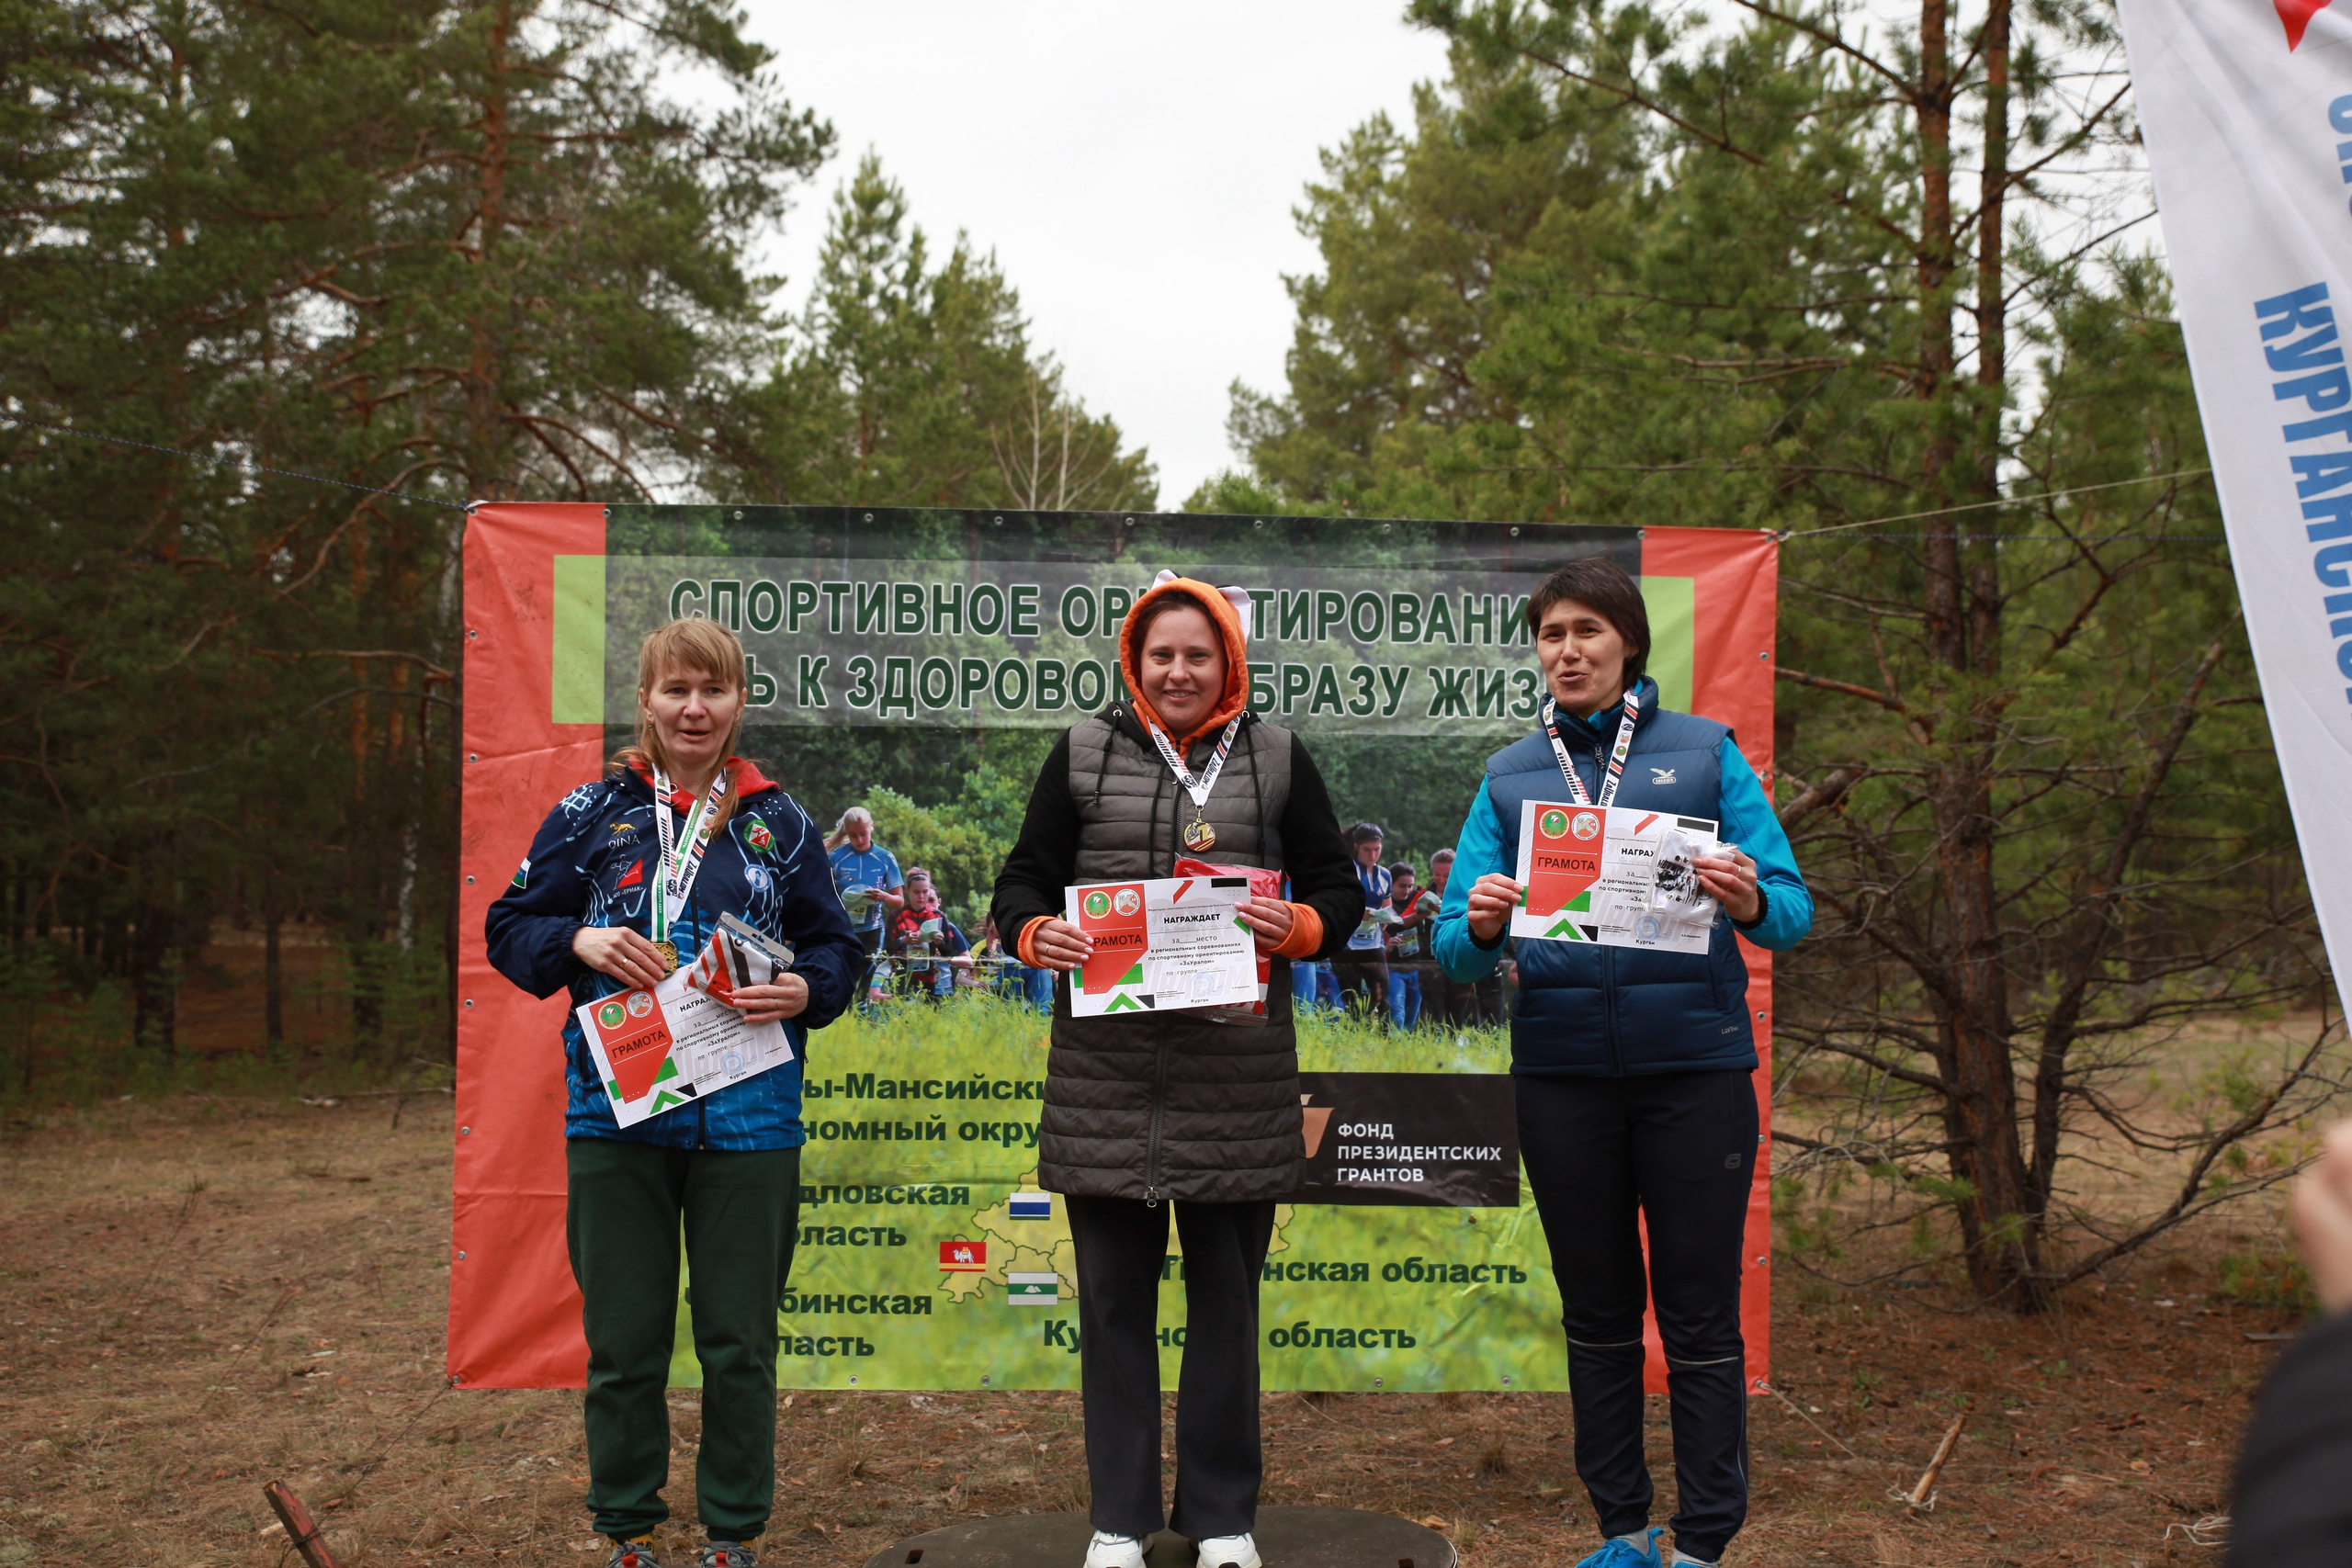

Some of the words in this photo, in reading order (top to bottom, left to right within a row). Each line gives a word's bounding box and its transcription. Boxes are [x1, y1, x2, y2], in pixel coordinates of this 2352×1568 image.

[2255, 281, 2352, 726] КУРГАН
[671, 579, 1040, 636] СПОРТИВНОЕ
[1060, 585, 1535, 647] ОРТИРОВАНИ
[798, 655, 829, 707] К
[847, 656, 1134, 718] ЗДОРОВО
[1246, 662, 1410, 717] БРАЗУ
[1427, 666, 1546, 719] ЖИЗ
[1621, 848, 1655, 857] НАГРА
[1537, 856, 1596, 872] ГРАМОТА
[1164, 913, 1220, 924] НАГРАЖДАЕТ
[1093, 933, 1143, 948] РАМОТА
[1197, 942, 1241, 951] соревнованиях
[1157, 953, 1194, 961] спортивному
[1195, 949, 1245, 958] ориентированию
[1177, 968, 1198, 976] группе
[680, 996, 711, 1012] НАГРА
[680, 1023, 718, 1044] региональных
[684, 1032, 719, 1050] спортивному
[612, 1030, 667, 1058] ГРАМОТА
[707, 1044, 728, 1057] группе
[729, 1070, 748, 1080] Курган
[804, 1073, 1045, 1100] ы-Мансийск
[803, 1114, 946, 1141] номный
[958, 1122, 1041, 1148] окру
[1338, 1122, 1395, 1140] ФОНД
[1338, 1145, 1502, 1161] ПРЕЗИДЕНТСКИХ
[1338, 1168, 1425, 1183] ГРАНТОВ
[799, 1183, 970, 1209] дловская
[795, 1225, 908, 1247] ласть
[1161, 1254, 1370, 1282] Тнская
[1381, 1256, 1528, 1284] область
[778, 1287, 933, 1314] бинская
[1268, 1320, 1417, 1349] область
[777, 1335, 876, 1357] ласть
